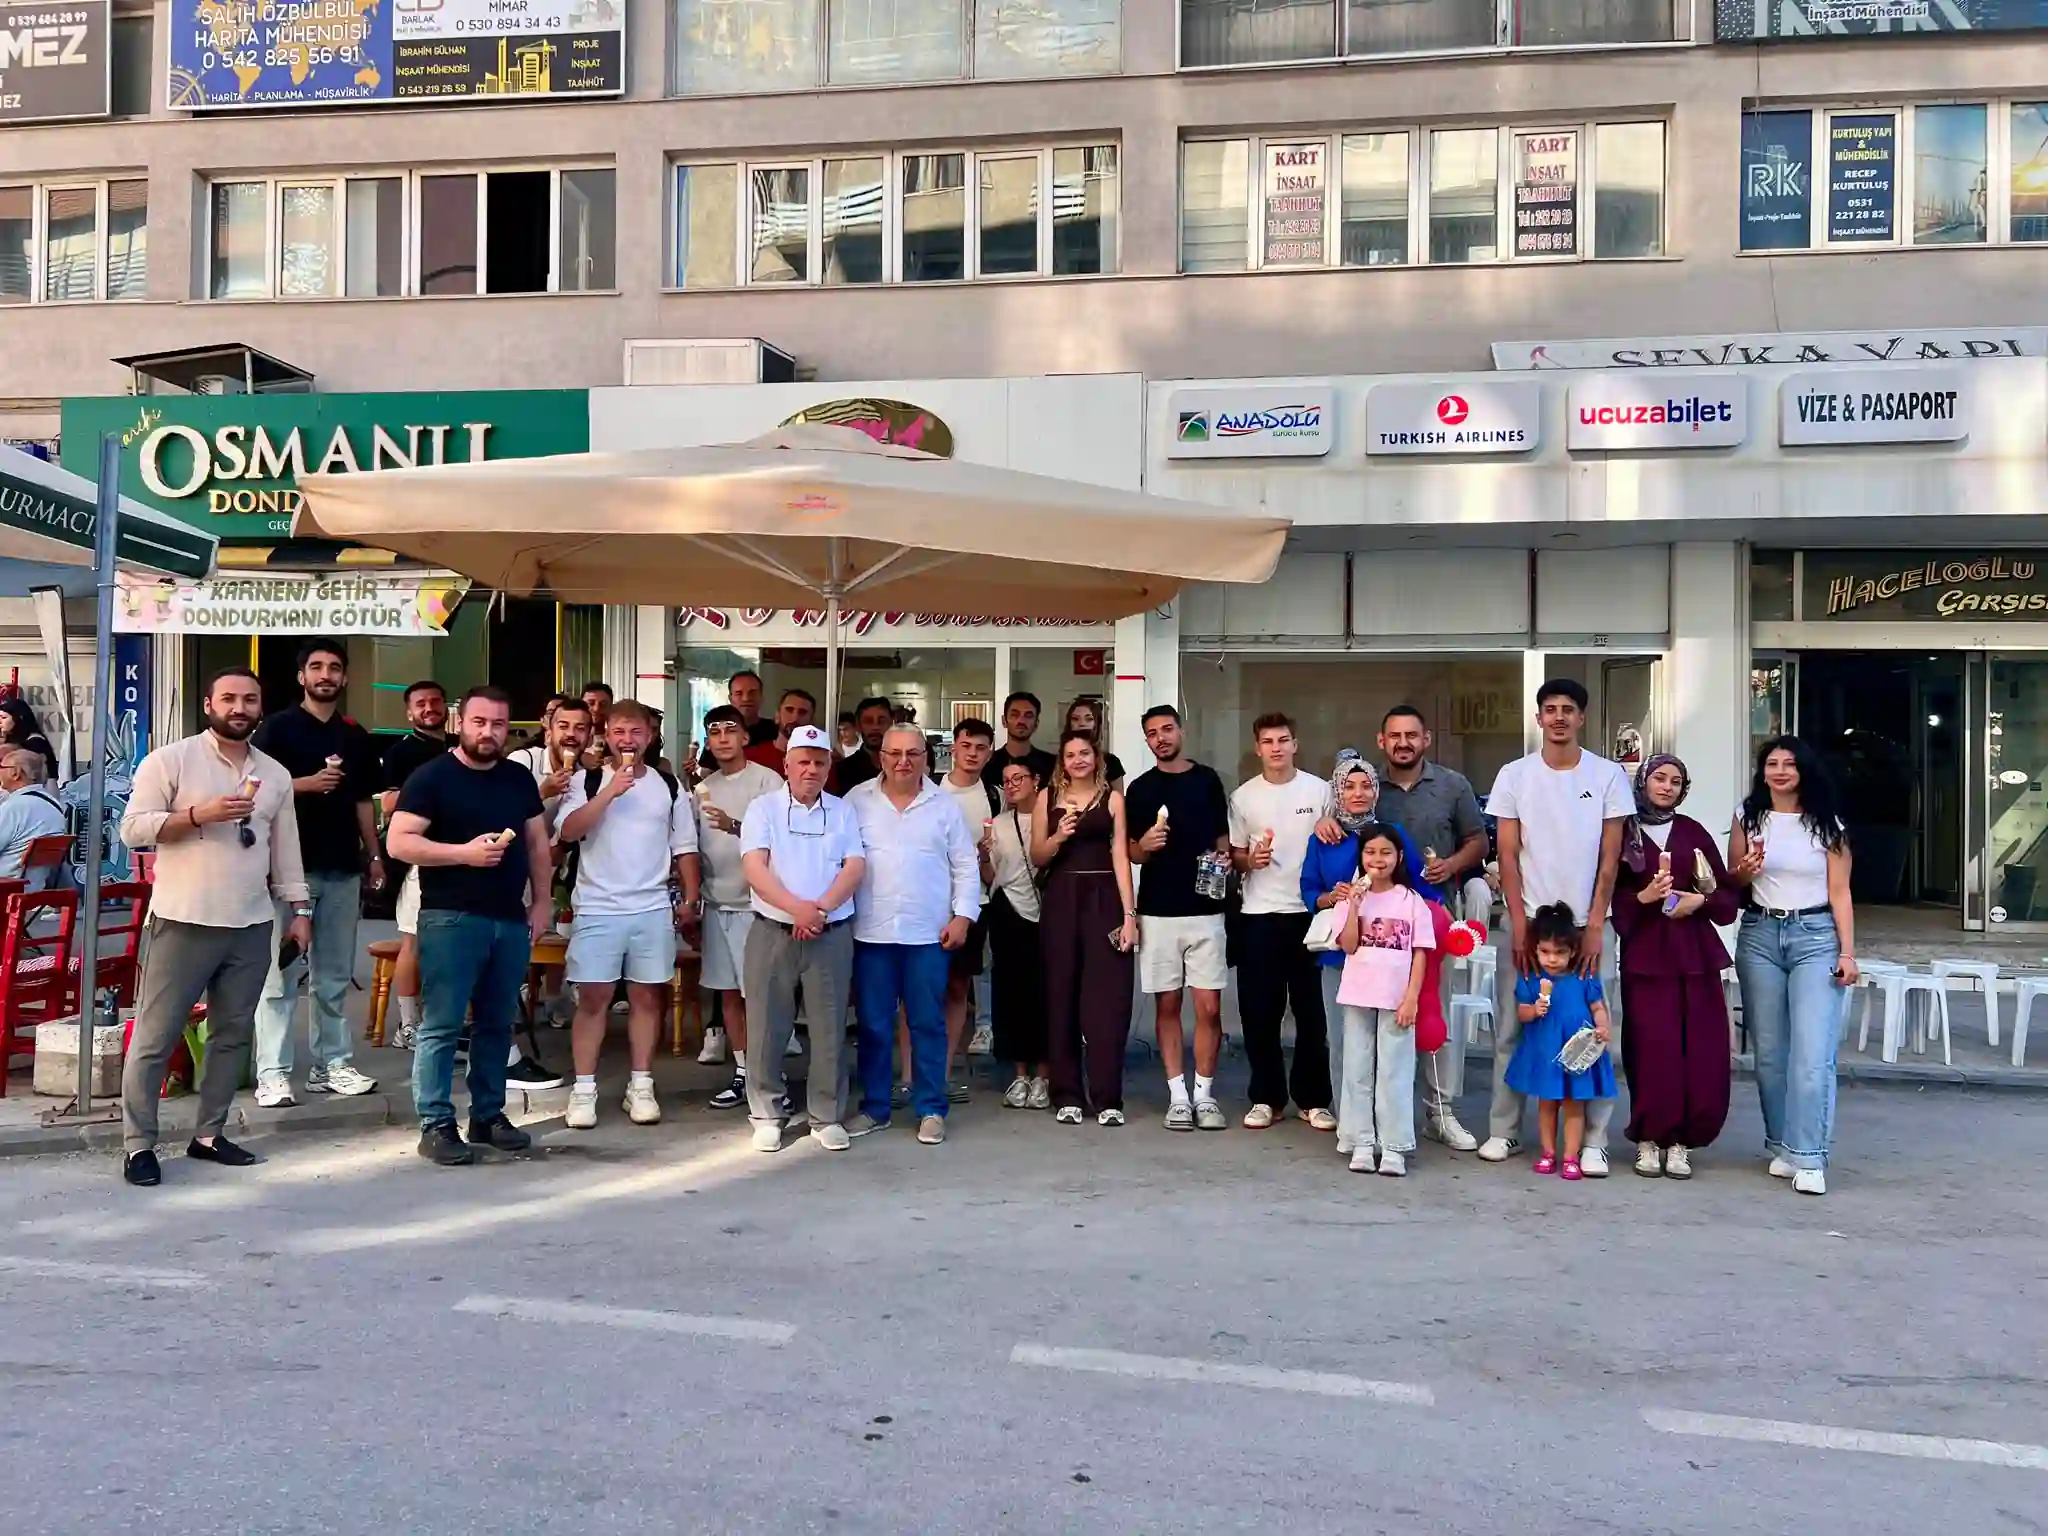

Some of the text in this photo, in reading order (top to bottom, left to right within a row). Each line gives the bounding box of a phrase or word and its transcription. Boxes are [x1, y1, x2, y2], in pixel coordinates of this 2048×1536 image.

[263, 0, 361, 22] ÖZBÜLBÜL
[1809, 4, 1852, 22] İnşaat
[1855, 3, 1928, 18] Mühendisi
[456, 20, 464, 31] 0
[469, 19, 493, 30] 530
[497, 17, 521, 29] 894
[525, 17, 541, 29] 34
[545, 16, 561, 28] 43
[195, 17, 367, 48] HARİTA MÜHENDİSİ
[433, 44, 467, 55] GÜLHAN
[572, 40, 600, 49] PROJE
[203, 47, 360, 69] 0 542 825 56 91
[211, 91, 243, 102] HARİTA
[254, 91, 304, 101] PLANLAMA
[315, 87, 370, 99] MÜŞAVİRLİK
[399, 86, 405, 94] 0
[407, 85, 424, 94] 543
[0, 93, 21, 108] EZ
[1526, 137, 1570, 153] KART
[1275, 151, 1318, 166] KART
[1844, 169, 1877, 178] RECEP
[1277, 173, 1316, 192] İNŞAAT
[1832, 181, 1889, 191] KURTULUŞ
[1848, 198, 1872, 207] 0531
[1835, 211, 1853, 220] 221
[1871, 210, 1885, 218] 82
[1580, 397, 1732, 425] ucuzabilet
[1798, 387, 1958, 423] VİZE & PASAPORT
[1216, 412, 1320, 429] ANADOLU
[1380, 430, 1525, 445] TURKISH AIRLINES
[0, 487, 97, 537] URMACI
[317, 575, 378, 601] GETİR
[1937, 590, 2048, 616] ÇARŞIS
[184, 603, 402, 629] DONDURMANI GÖTÜR
